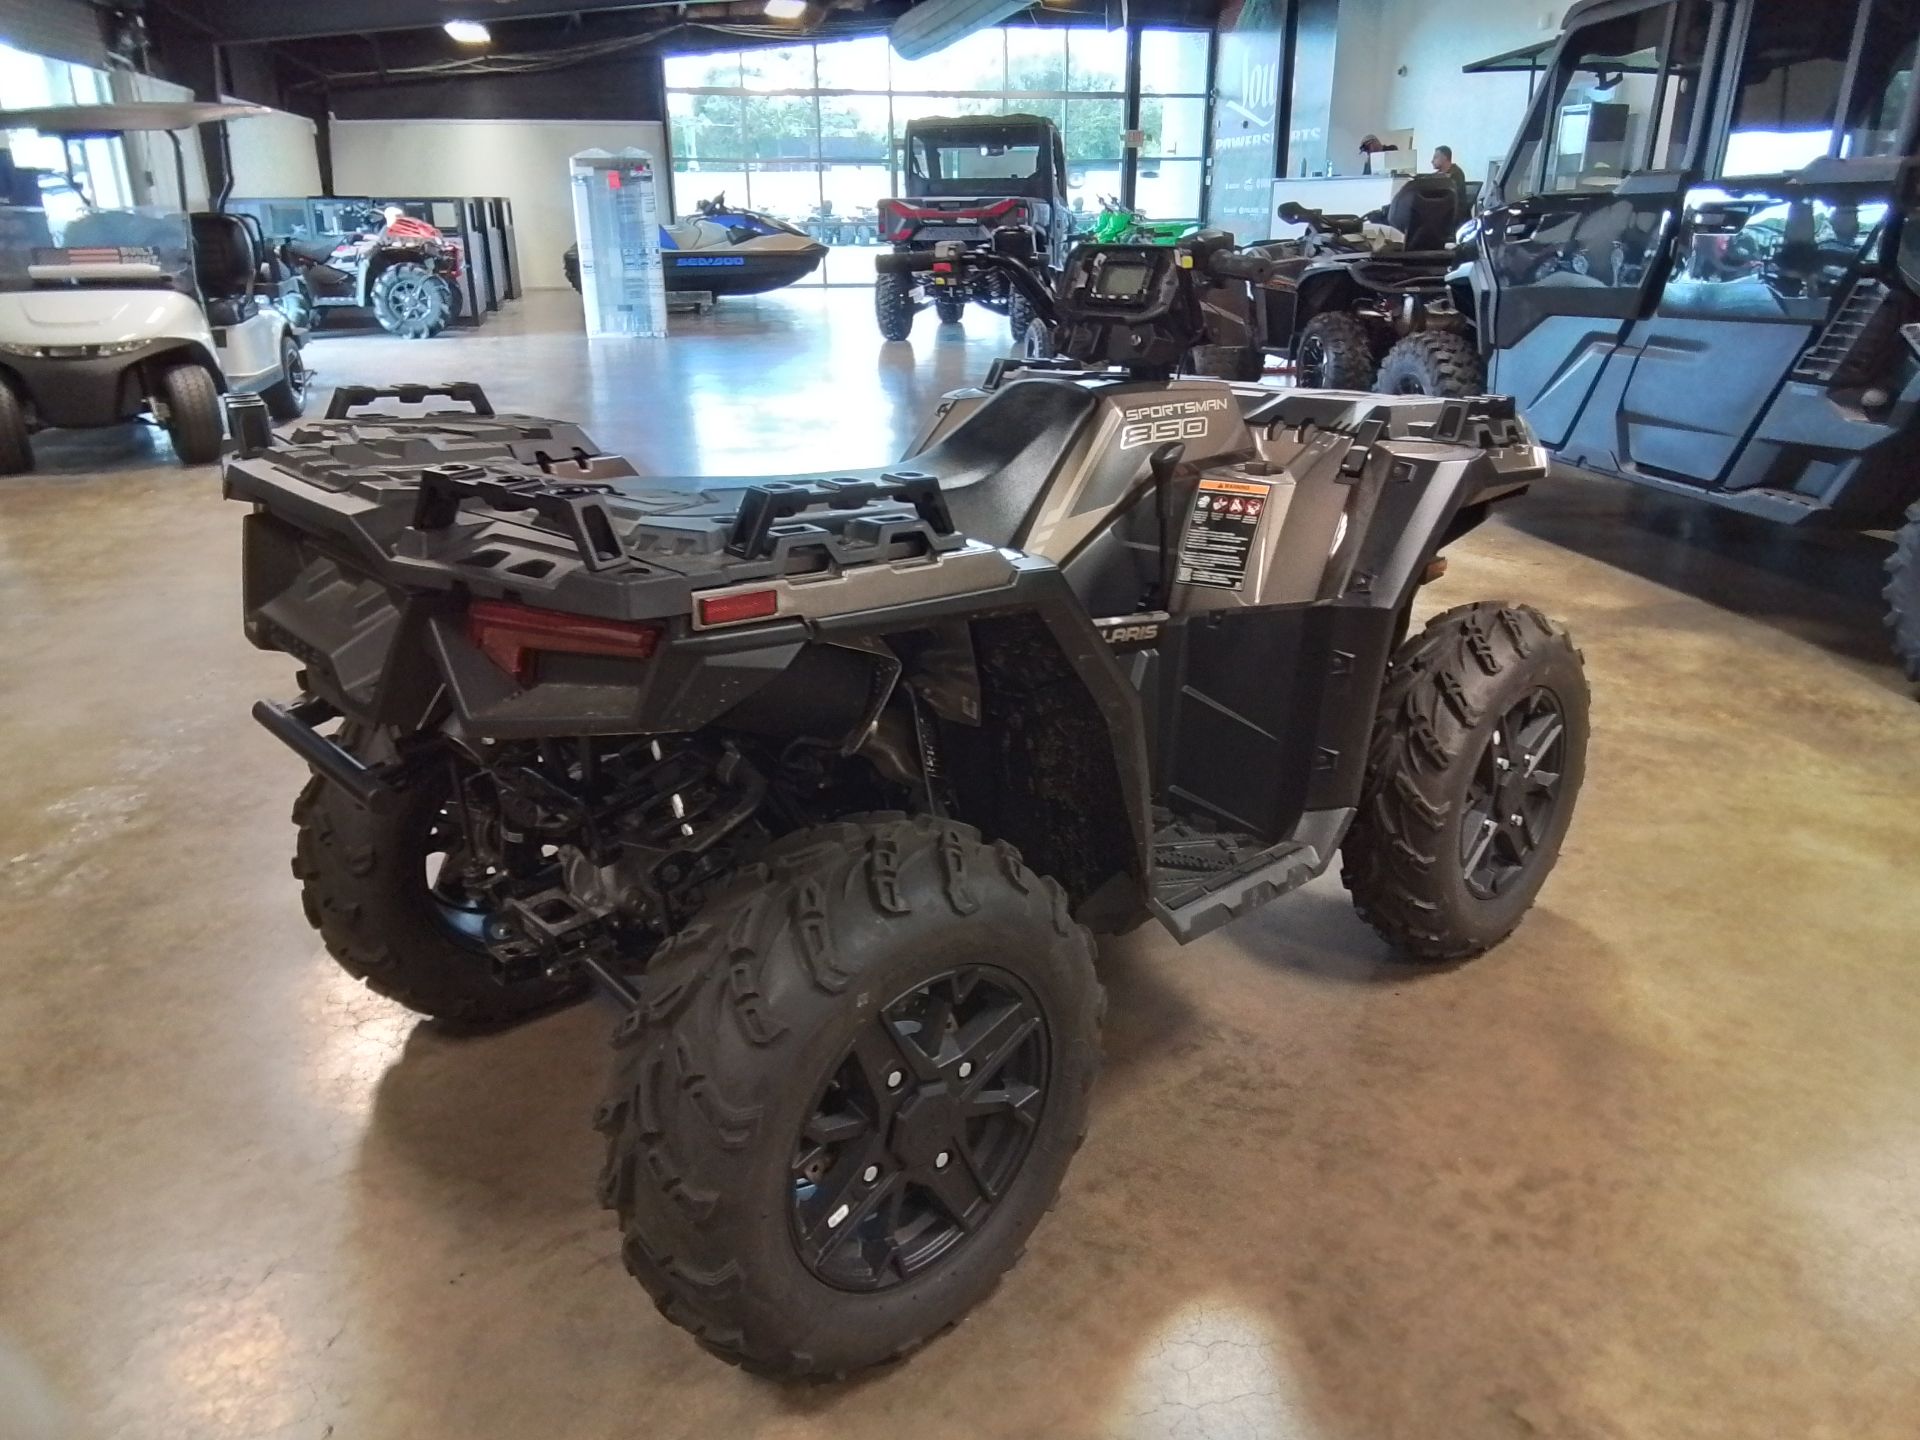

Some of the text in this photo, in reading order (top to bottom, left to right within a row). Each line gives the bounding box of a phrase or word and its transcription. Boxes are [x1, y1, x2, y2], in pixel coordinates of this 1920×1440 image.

[1127, 398, 1227, 422] SPORTSMAN
[1121, 416, 1208, 449] 850
[1102, 625, 1158, 644] LARIS
